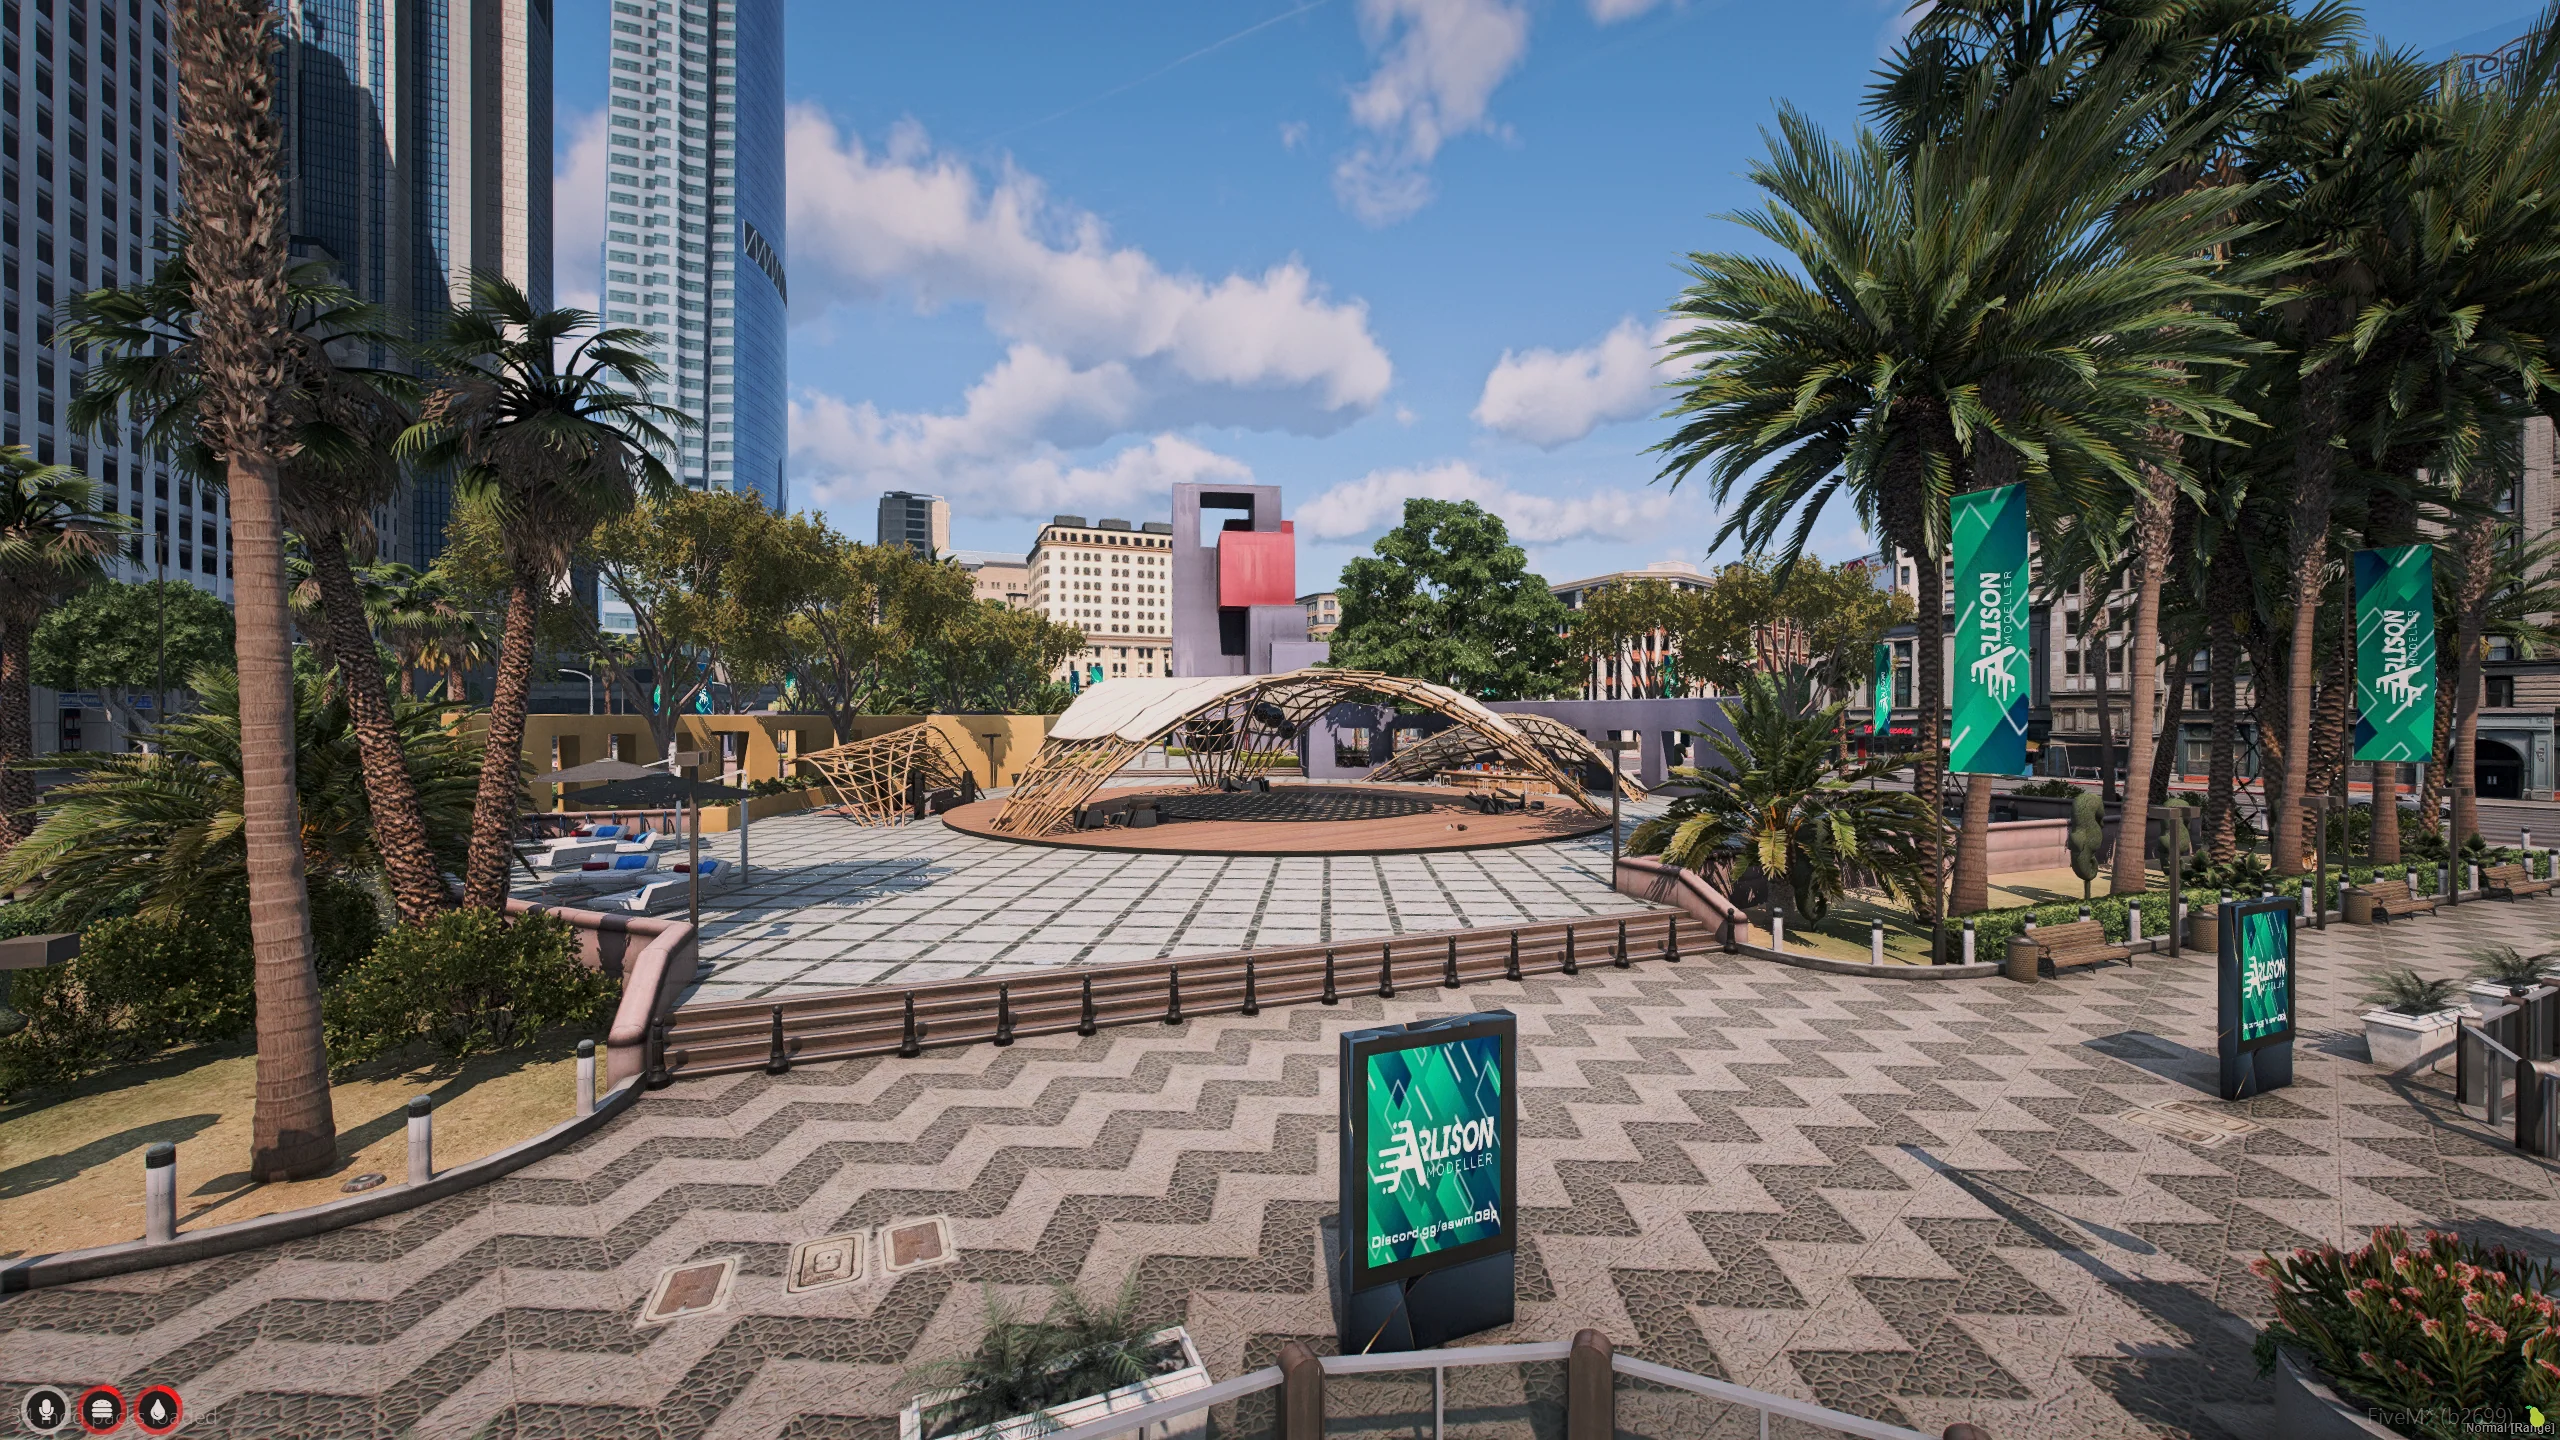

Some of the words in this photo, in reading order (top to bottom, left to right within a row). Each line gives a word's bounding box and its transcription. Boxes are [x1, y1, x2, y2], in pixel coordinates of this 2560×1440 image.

[1970, 572, 2017, 702] ARLISON
[2003, 570, 2013, 645] MODELLER
[2407, 609, 2419, 666] MODELLER
[2376, 609, 2422, 707] ARLISON
[1375, 1116, 1494, 1194] ARLISON
[1426, 1152, 1494, 1178] MODELLER
